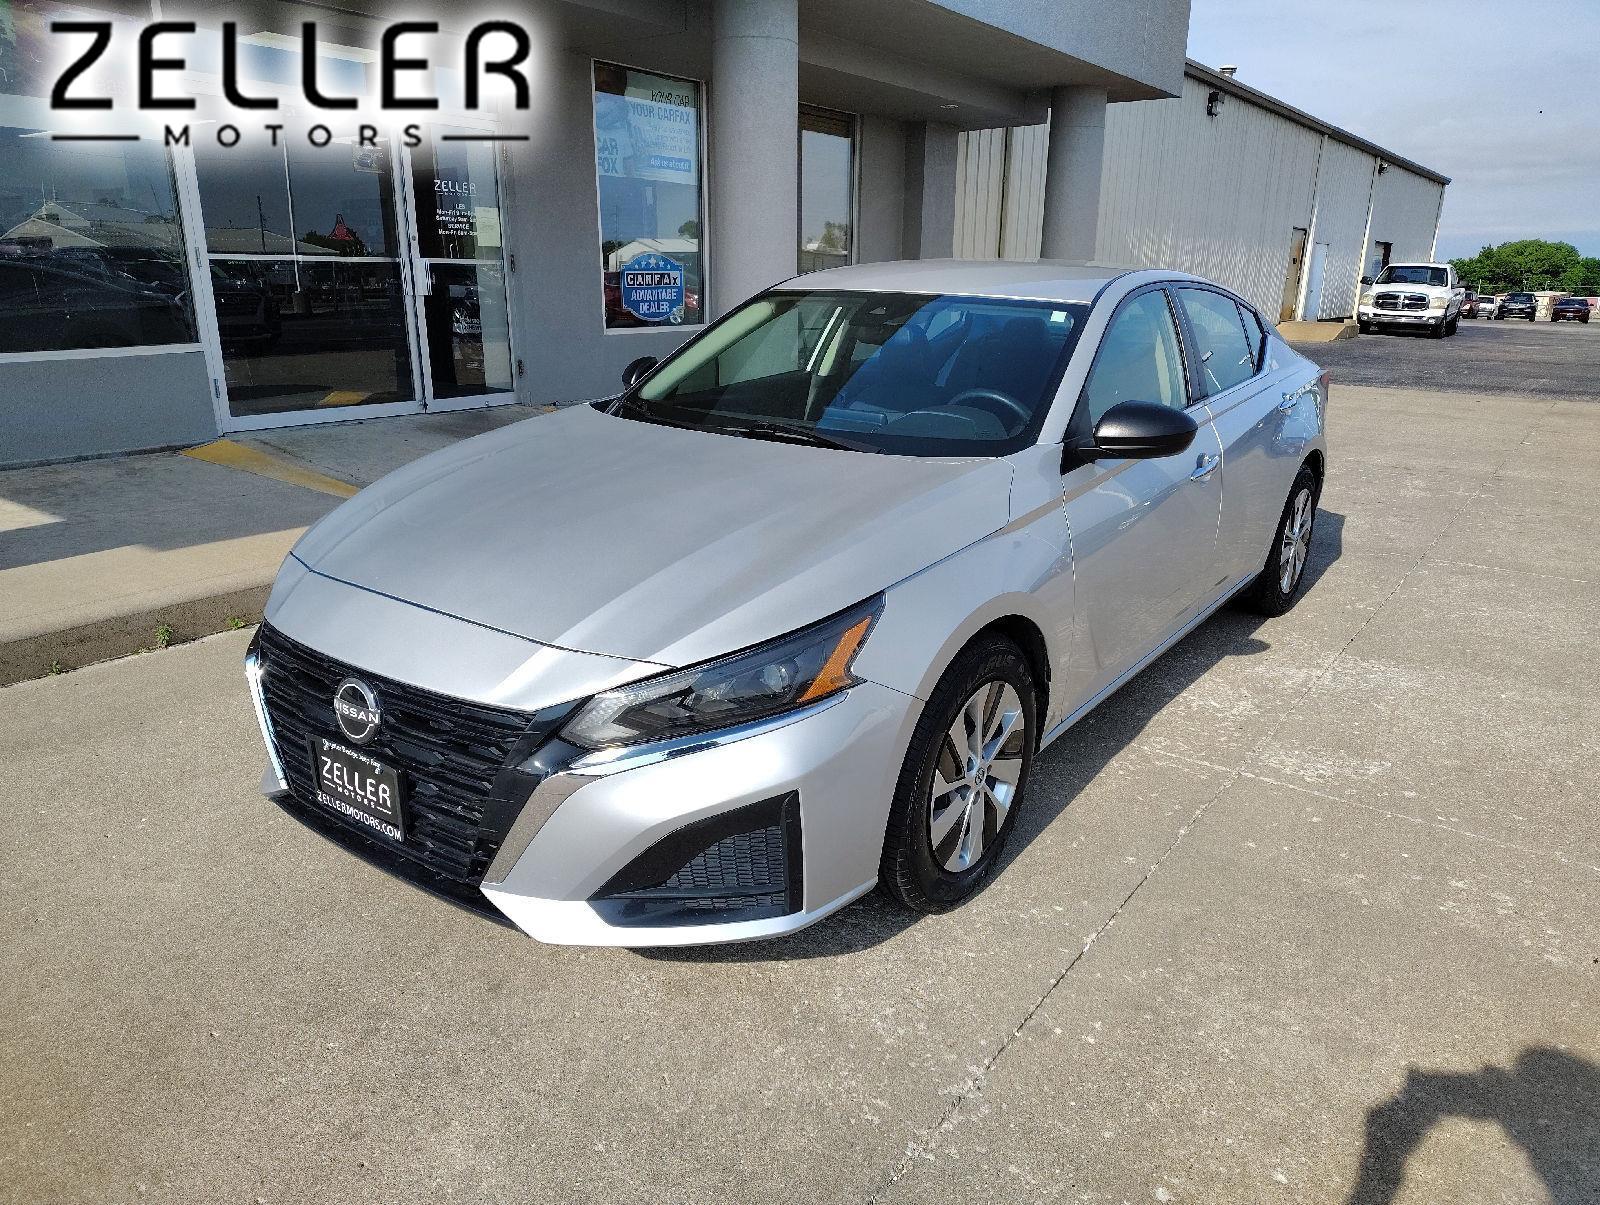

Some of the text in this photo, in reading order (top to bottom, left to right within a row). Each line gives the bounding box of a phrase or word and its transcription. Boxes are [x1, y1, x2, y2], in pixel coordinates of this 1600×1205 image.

[630, 102, 691, 125] YOUR CARFAX
[434, 179, 477, 194] ZELLER
[626, 272, 680, 286] CARFAX
[631, 288, 679, 301] ADVANTAGE
[639, 301, 670, 314] DEALER
[335, 698, 379, 724] NISSAN
[321, 755, 391, 808] ZELLER
[316, 789, 403, 842] ZELLERMOTORS.COM
